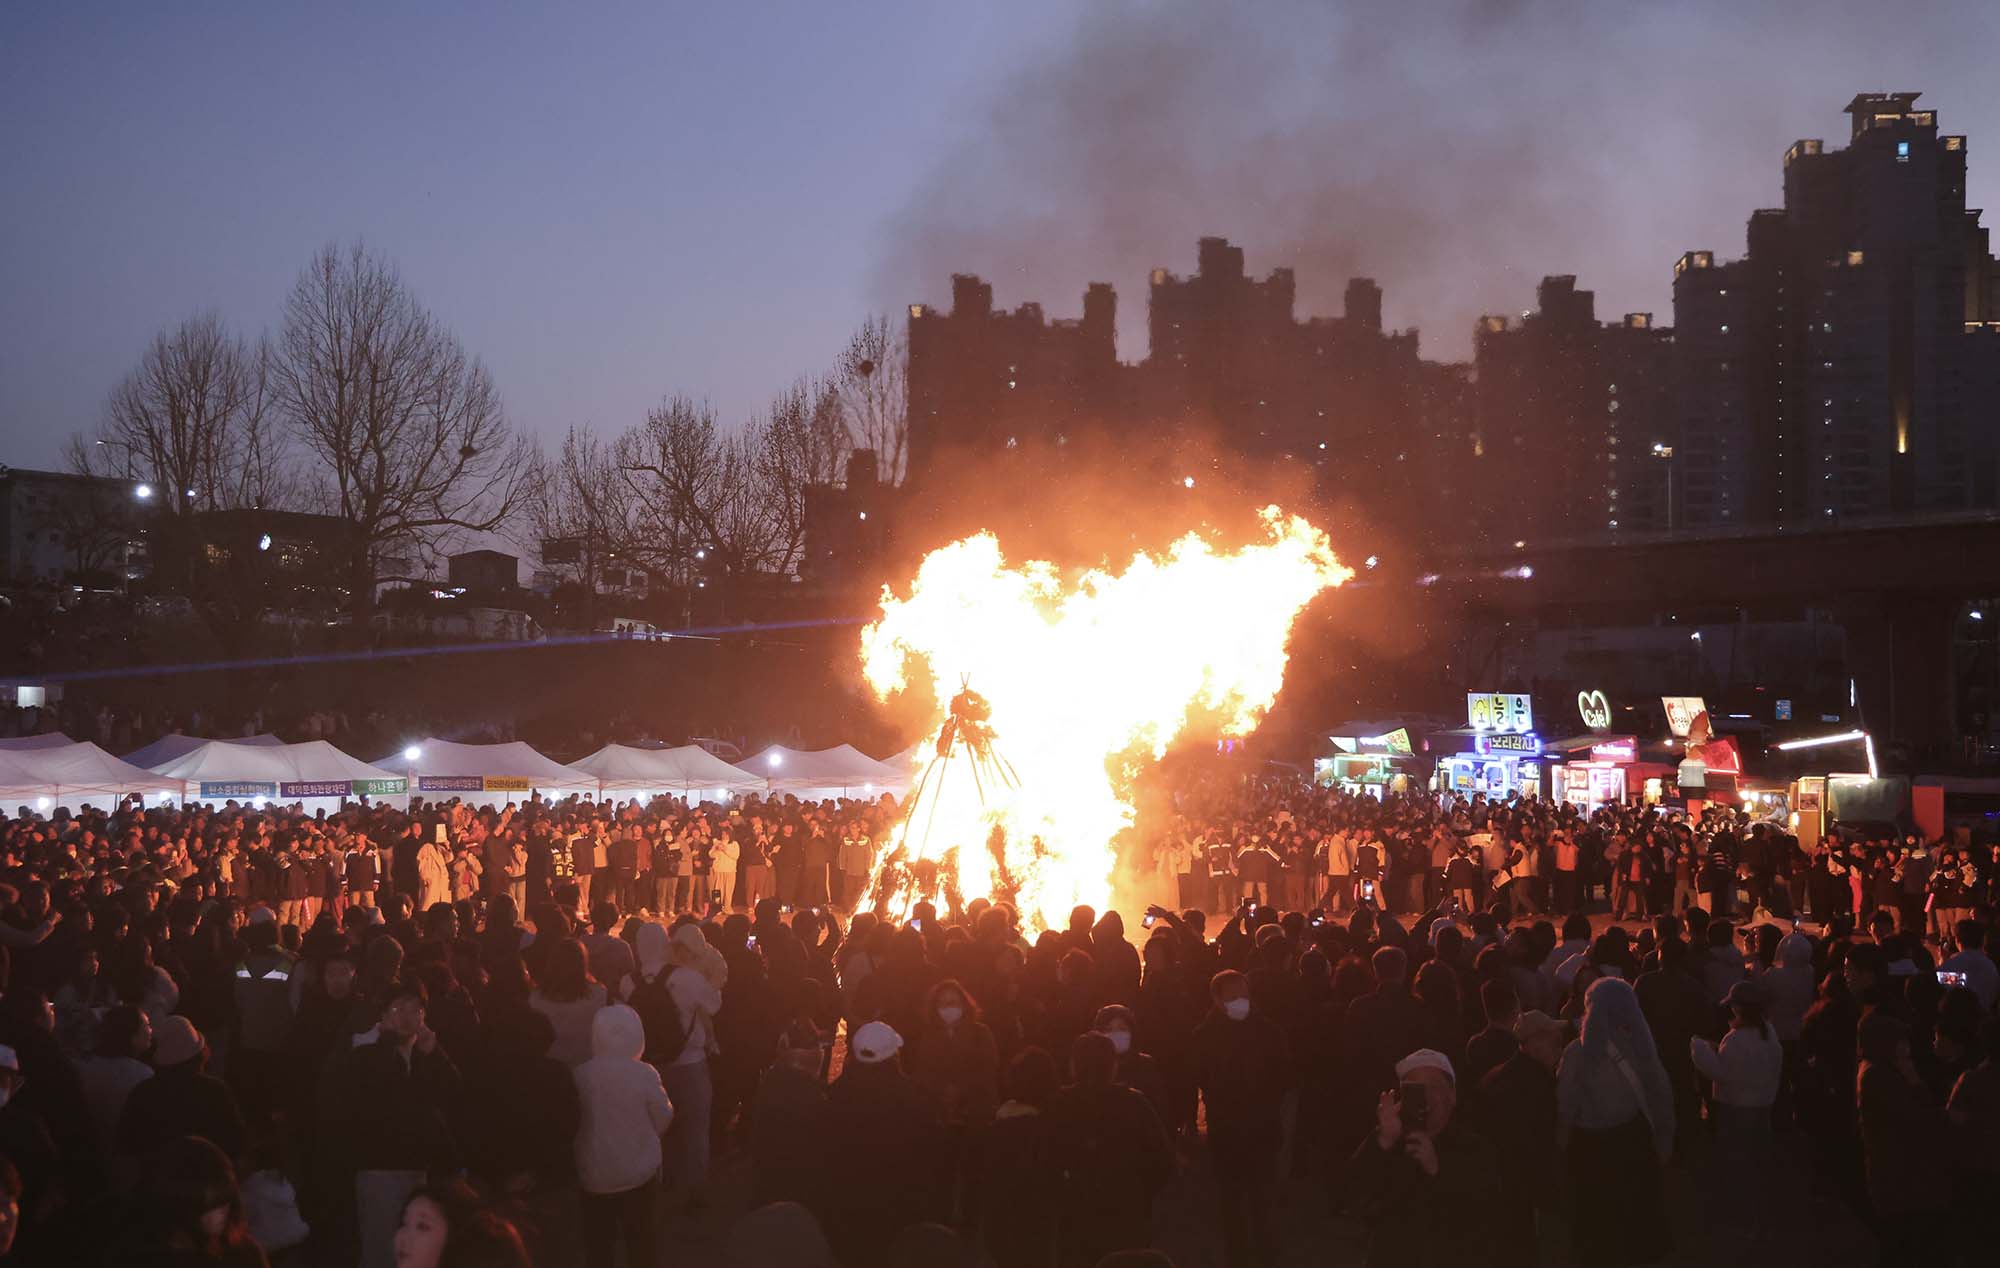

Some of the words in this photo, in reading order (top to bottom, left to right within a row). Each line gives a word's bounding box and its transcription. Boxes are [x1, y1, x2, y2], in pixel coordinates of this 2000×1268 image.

[1584, 709, 1605, 729] Café
[287, 783, 346, 795] 대덕문화관광재단
[368, 781, 404, 793] 하나은행
